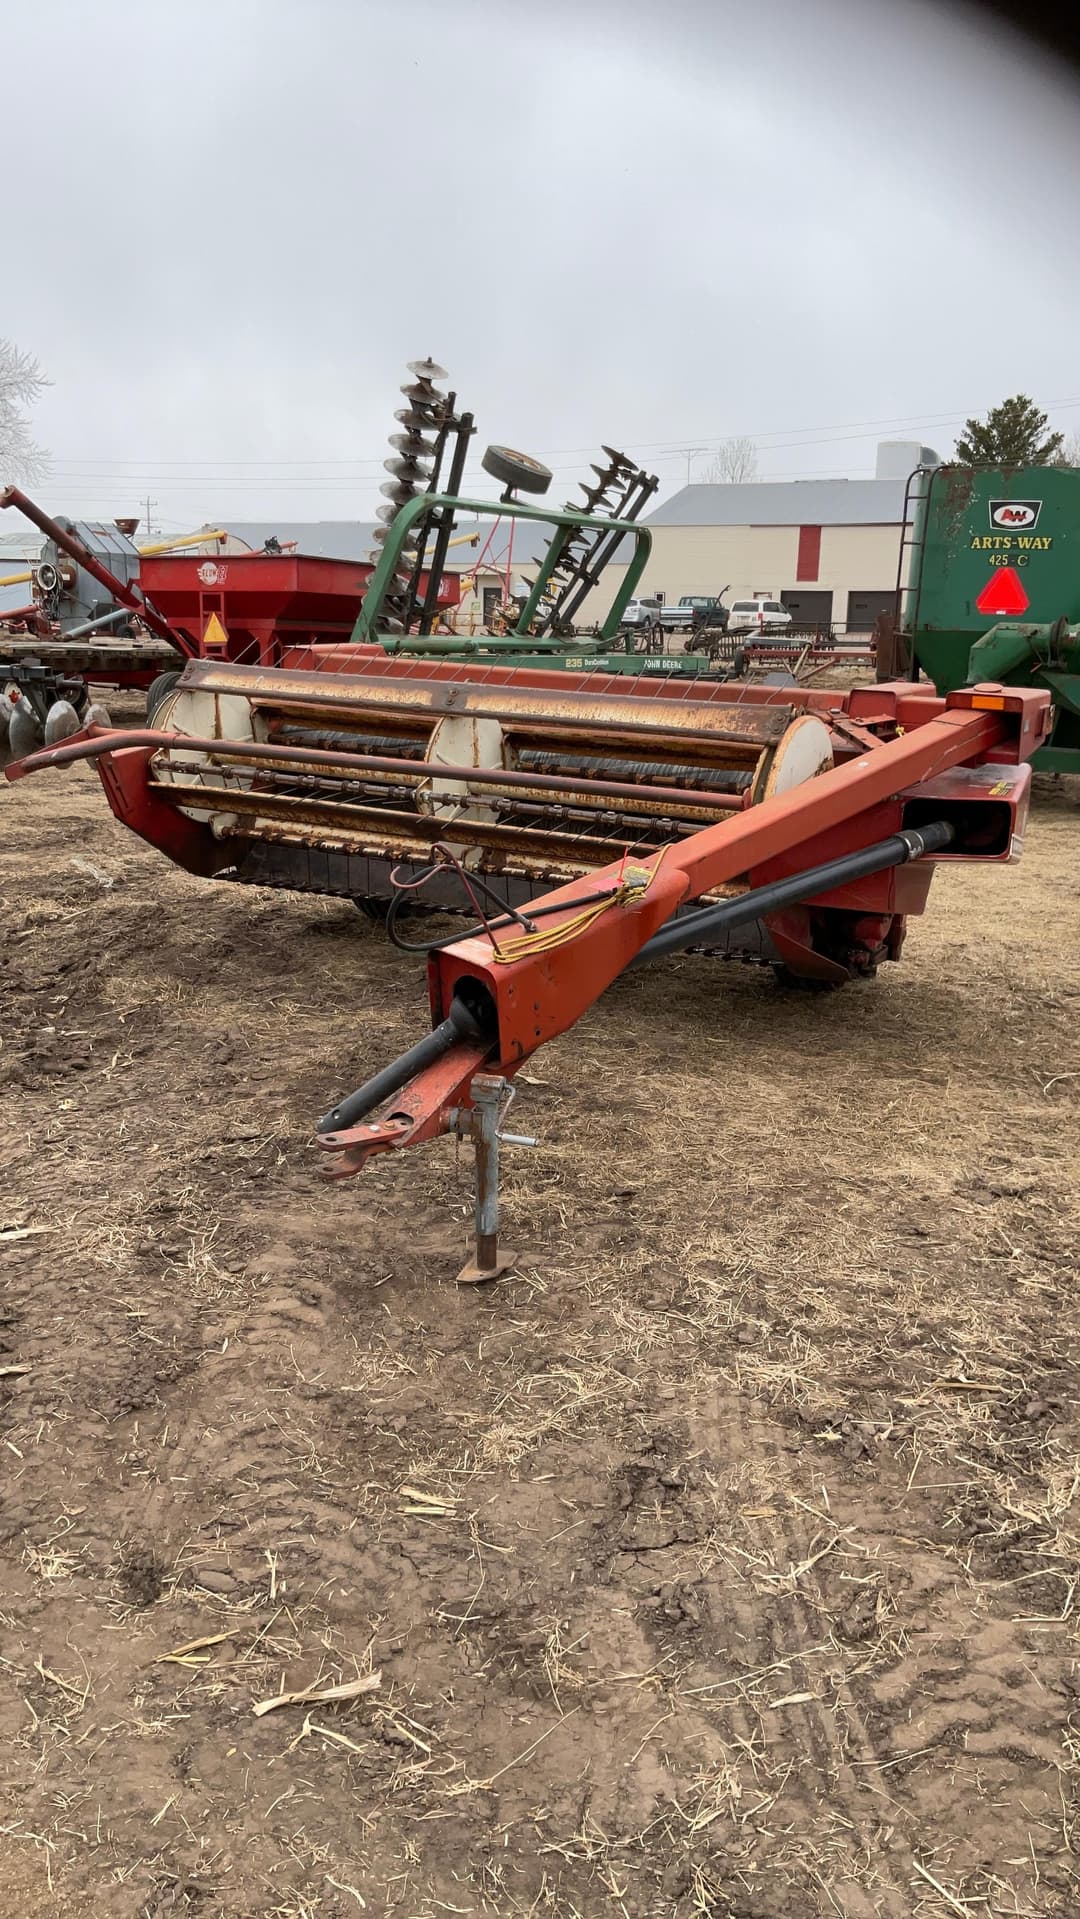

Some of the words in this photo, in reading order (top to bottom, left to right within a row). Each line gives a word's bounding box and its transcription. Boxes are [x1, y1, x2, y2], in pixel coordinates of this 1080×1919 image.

[971, 537, 1052, 549] ARTS-WAY
[644, 659, 661, 668] JOHN
[662, 660, 682, 669] DEERE
